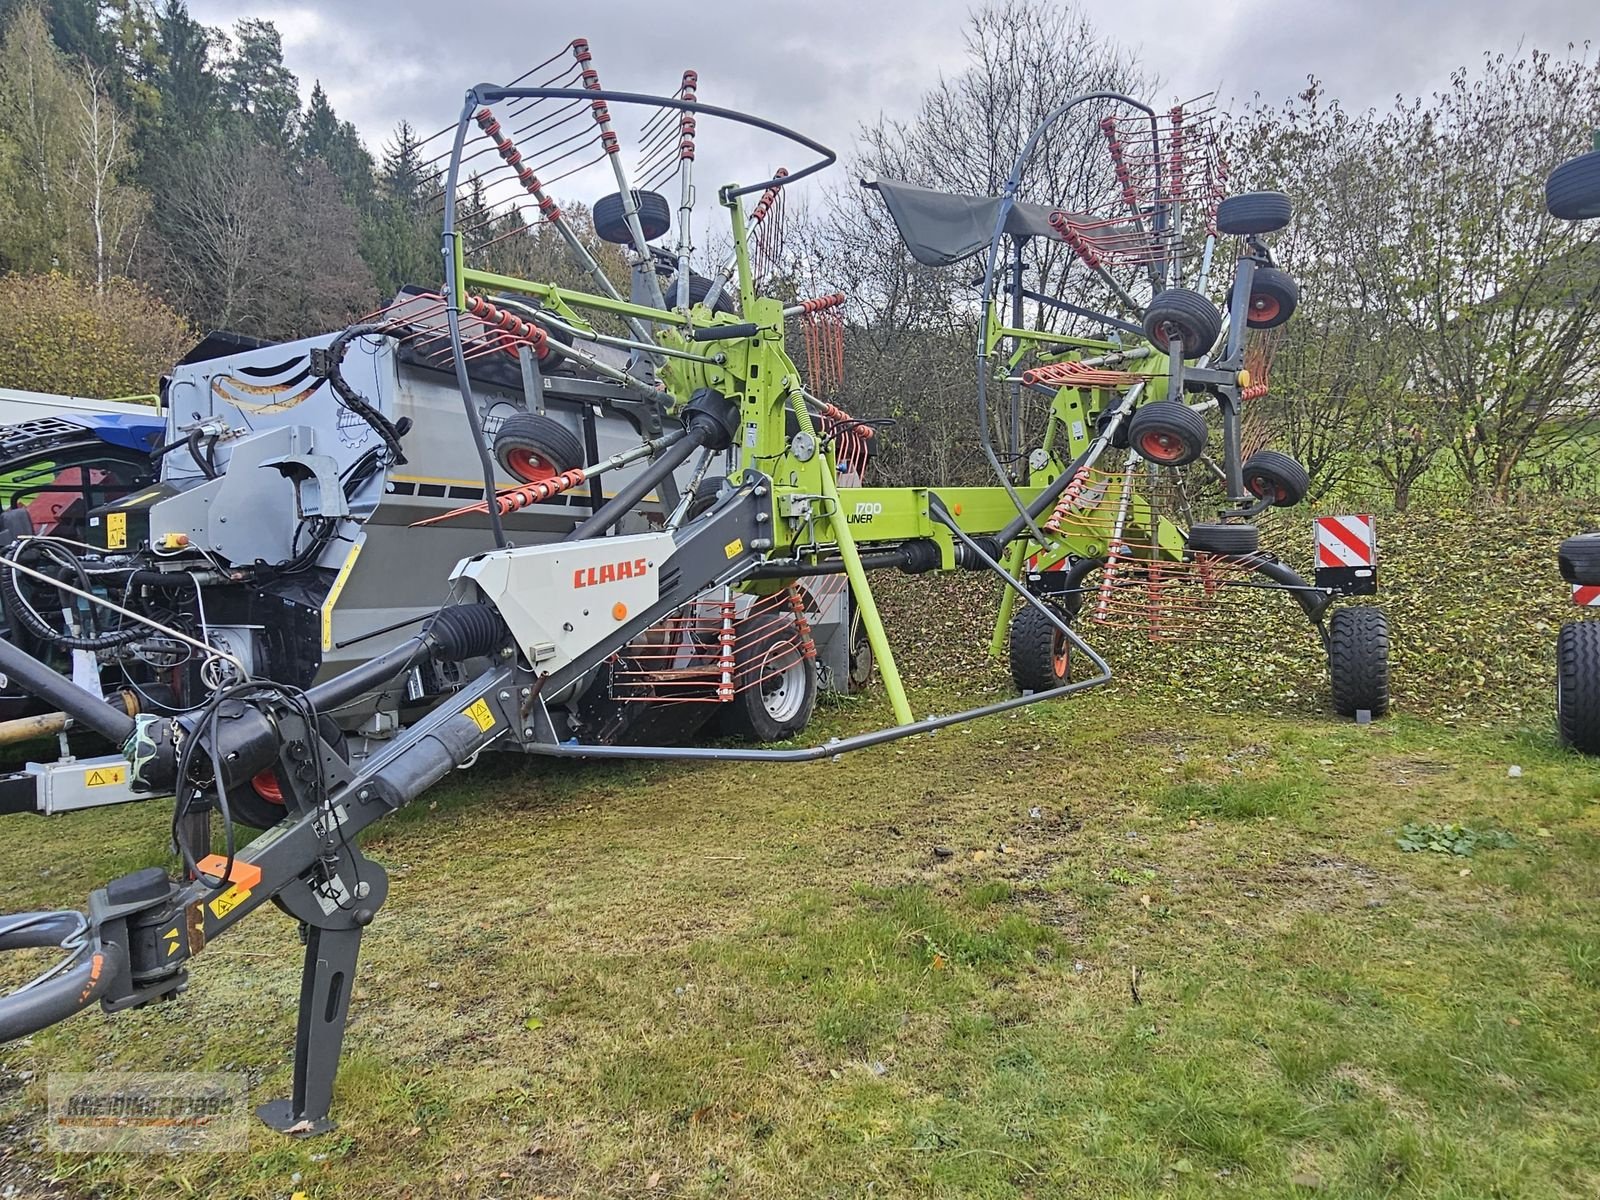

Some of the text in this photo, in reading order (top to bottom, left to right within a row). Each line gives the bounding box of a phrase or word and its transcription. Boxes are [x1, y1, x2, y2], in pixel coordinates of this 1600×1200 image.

[855, 502, 882, 515] 1700
[846, 513, 873, 524] LINER
[574, 558, 646, 589] CLAAS
